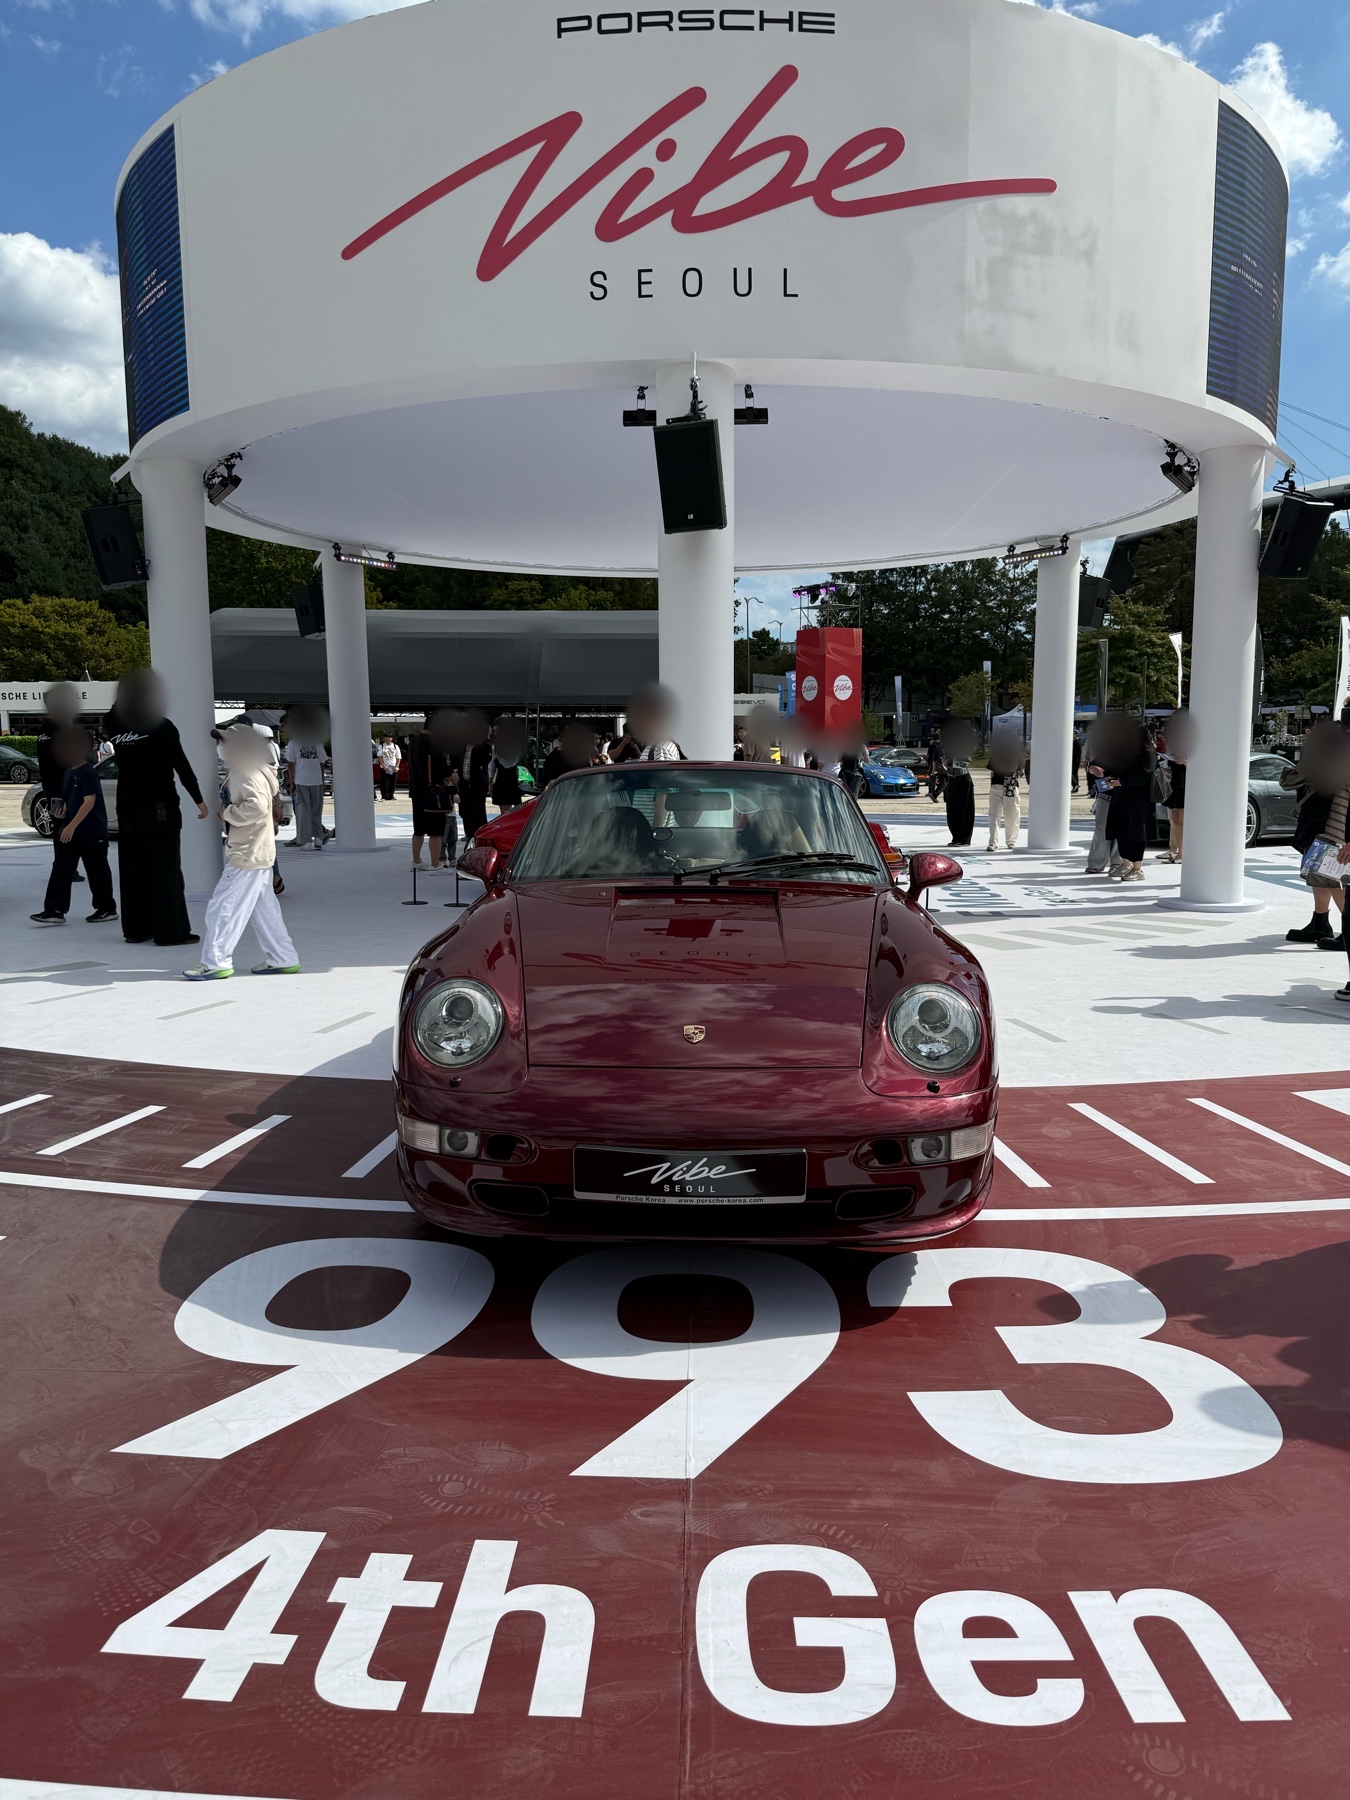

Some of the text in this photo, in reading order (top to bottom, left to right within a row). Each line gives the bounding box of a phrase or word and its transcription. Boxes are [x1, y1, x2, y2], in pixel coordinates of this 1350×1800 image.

[556, 9, 836, 39] PORSCHE
[341, 64, 1057, 282] Vibe
[589, 267, 799, 301] SEOUL
[109, 731, 149, 744] Vibe
[623, 1157, 757, 1184] Vibe
[615, 1194, 644, 1203] Porsche
[677, 1197, 764, 1205] www.porsche-korea.com
[663, 1184, 716, 1193] SEOUL
[112, 1237, 1284, 1485] 993
[100, 1529, 1293, 1727] 4th Gen
